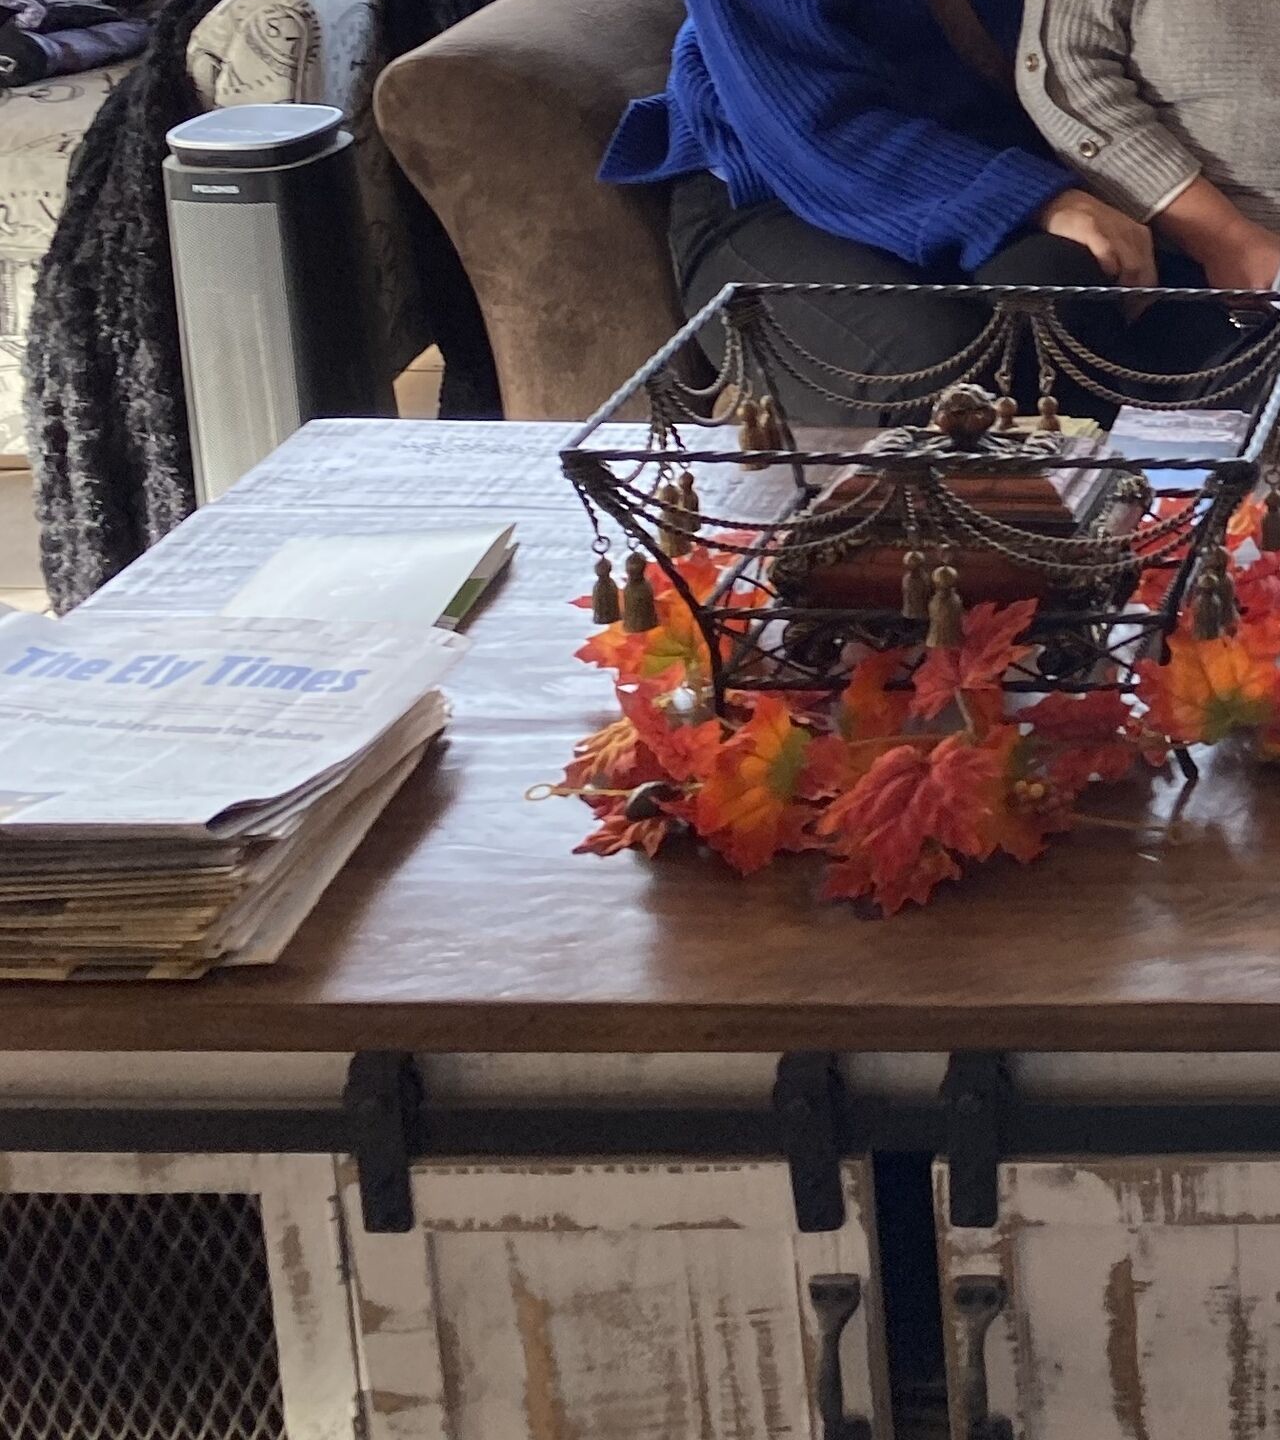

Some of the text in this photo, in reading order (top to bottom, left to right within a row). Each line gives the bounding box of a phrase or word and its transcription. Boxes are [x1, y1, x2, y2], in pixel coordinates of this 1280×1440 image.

[3, 646, 372, 693] The Ely Times
